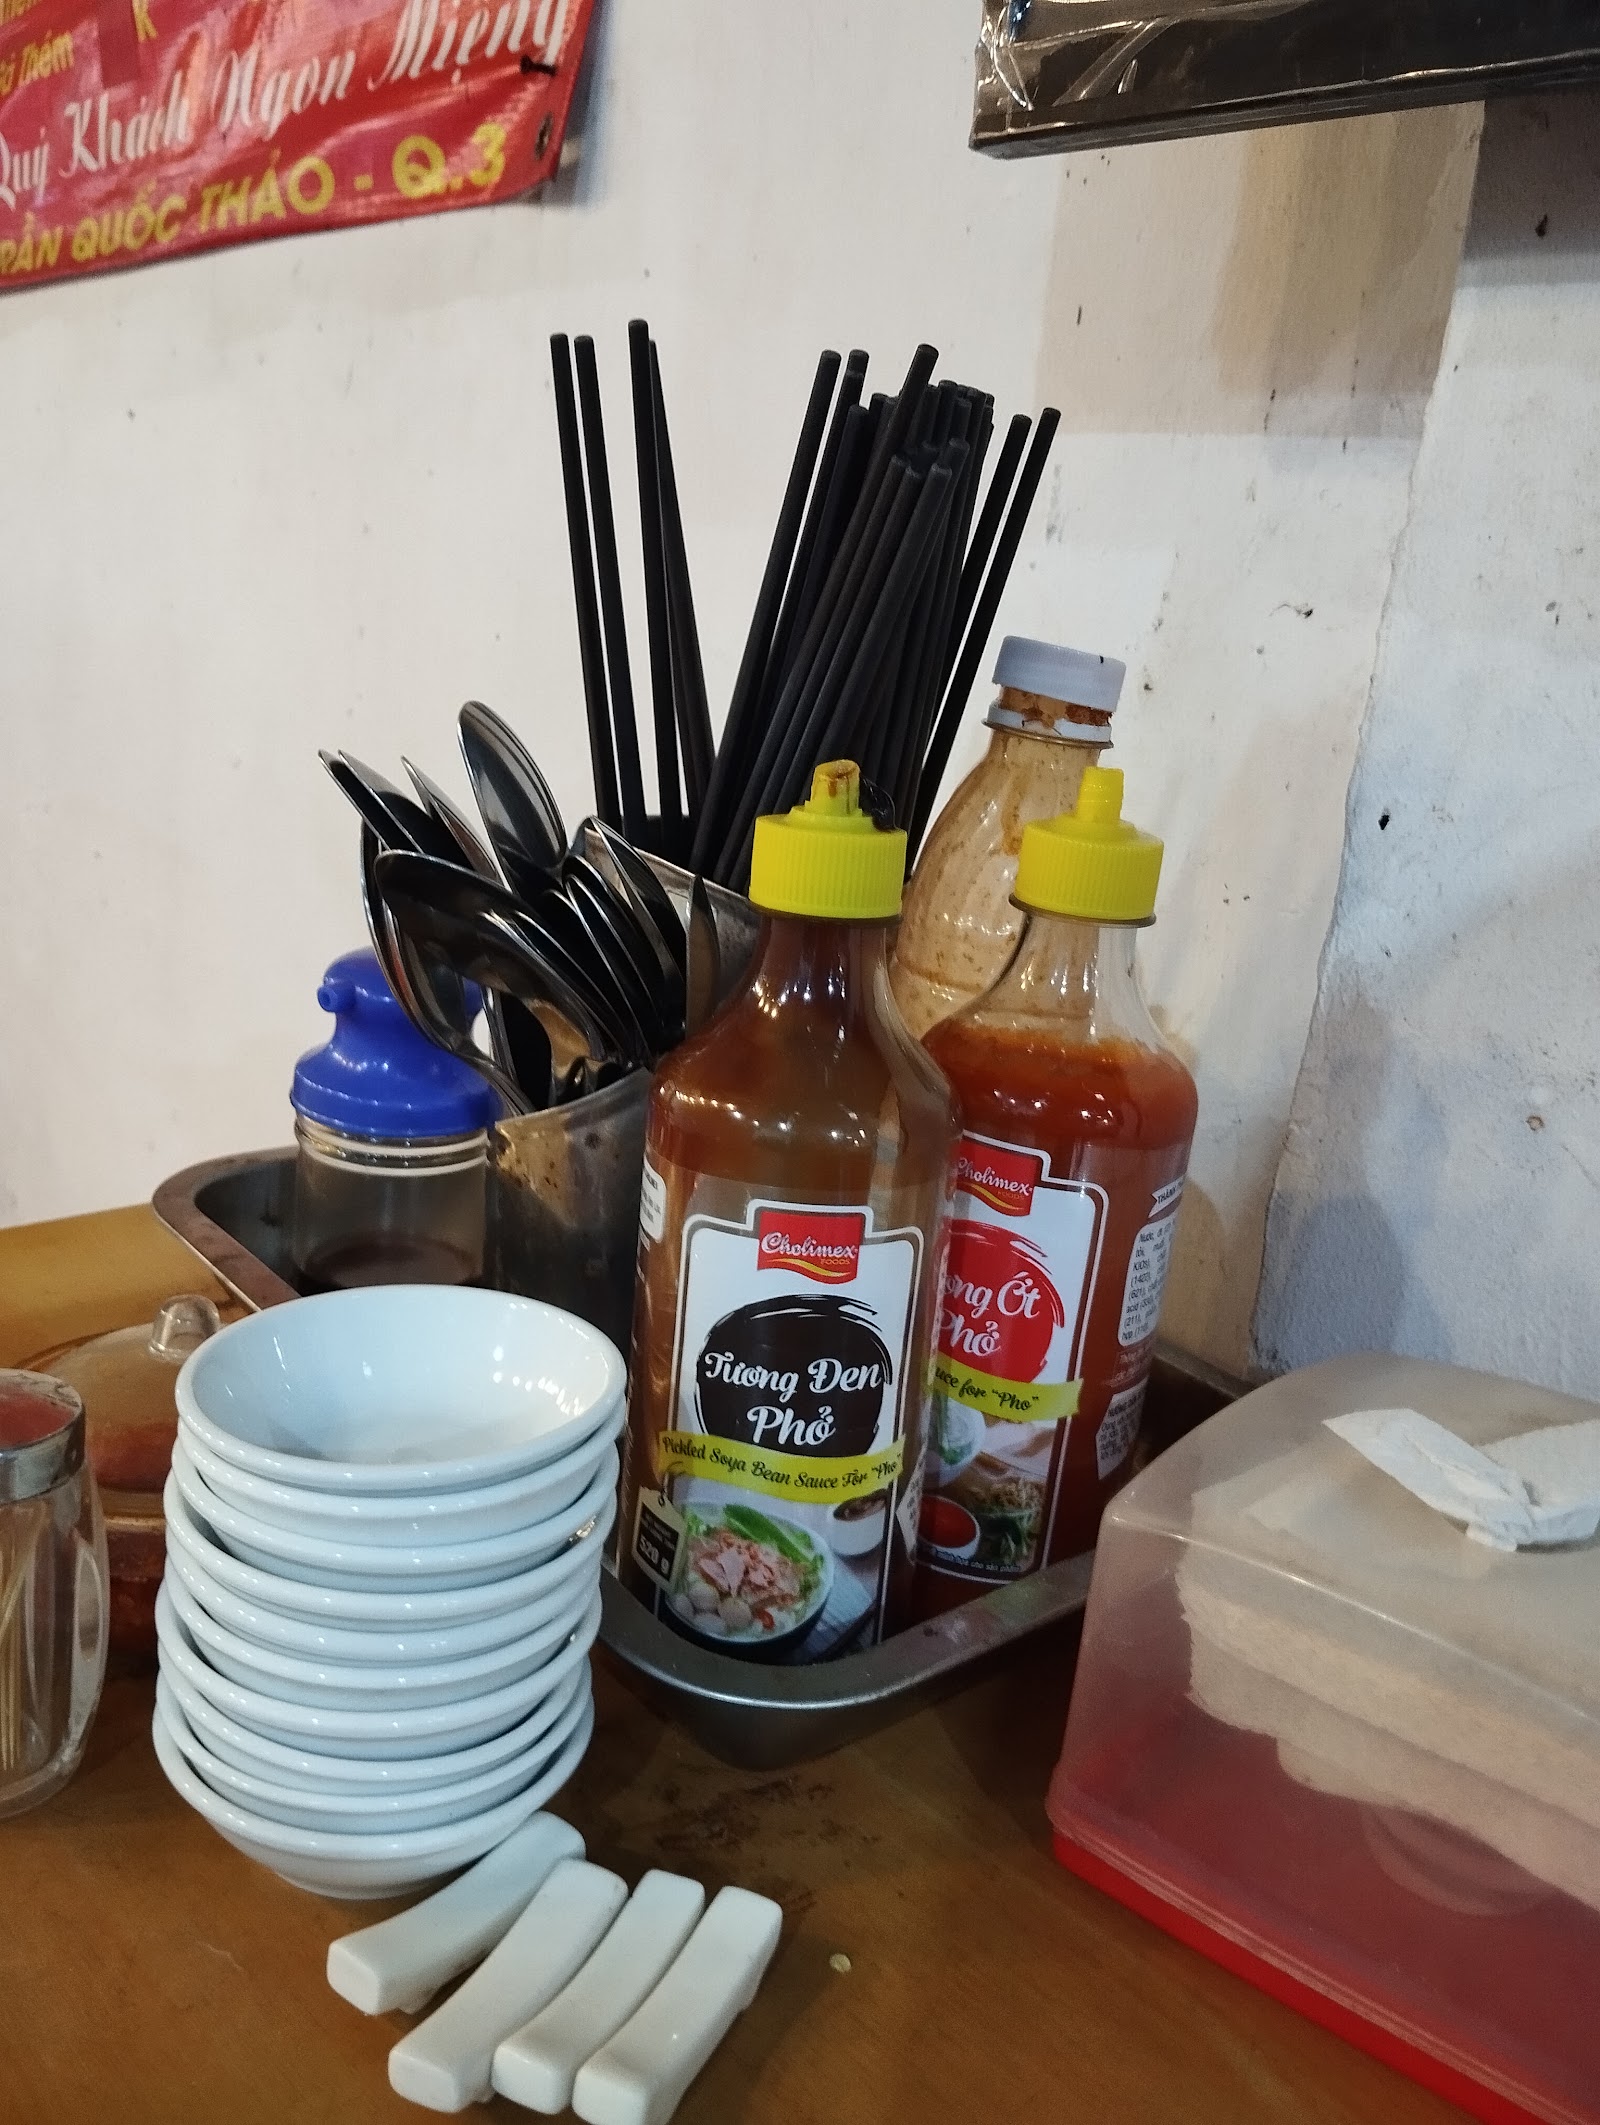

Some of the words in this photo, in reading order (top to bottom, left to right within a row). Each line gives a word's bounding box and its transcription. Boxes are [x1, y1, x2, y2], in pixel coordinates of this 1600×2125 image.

[71, 176, 188, 262] QUỐC
[392, 123, 506, 198] Q.3
[760, 1231, 859, 1260] Cholimex
[997, 1271, 1041, 1319] Ớt
[703, 1351, 799, 1403] Tương
[807, 1357, 881, 1394] Đen
[958, 1378, 987, 1398] for
[746, 1404, 836, 1446] Phở
[662, 1435, 706, 1461] Pickled
[709, 1446, 747, 1473] Soya
[750, 1459, 791, 1486] Bean
[794, 1471, 838, 1489] Sauce
